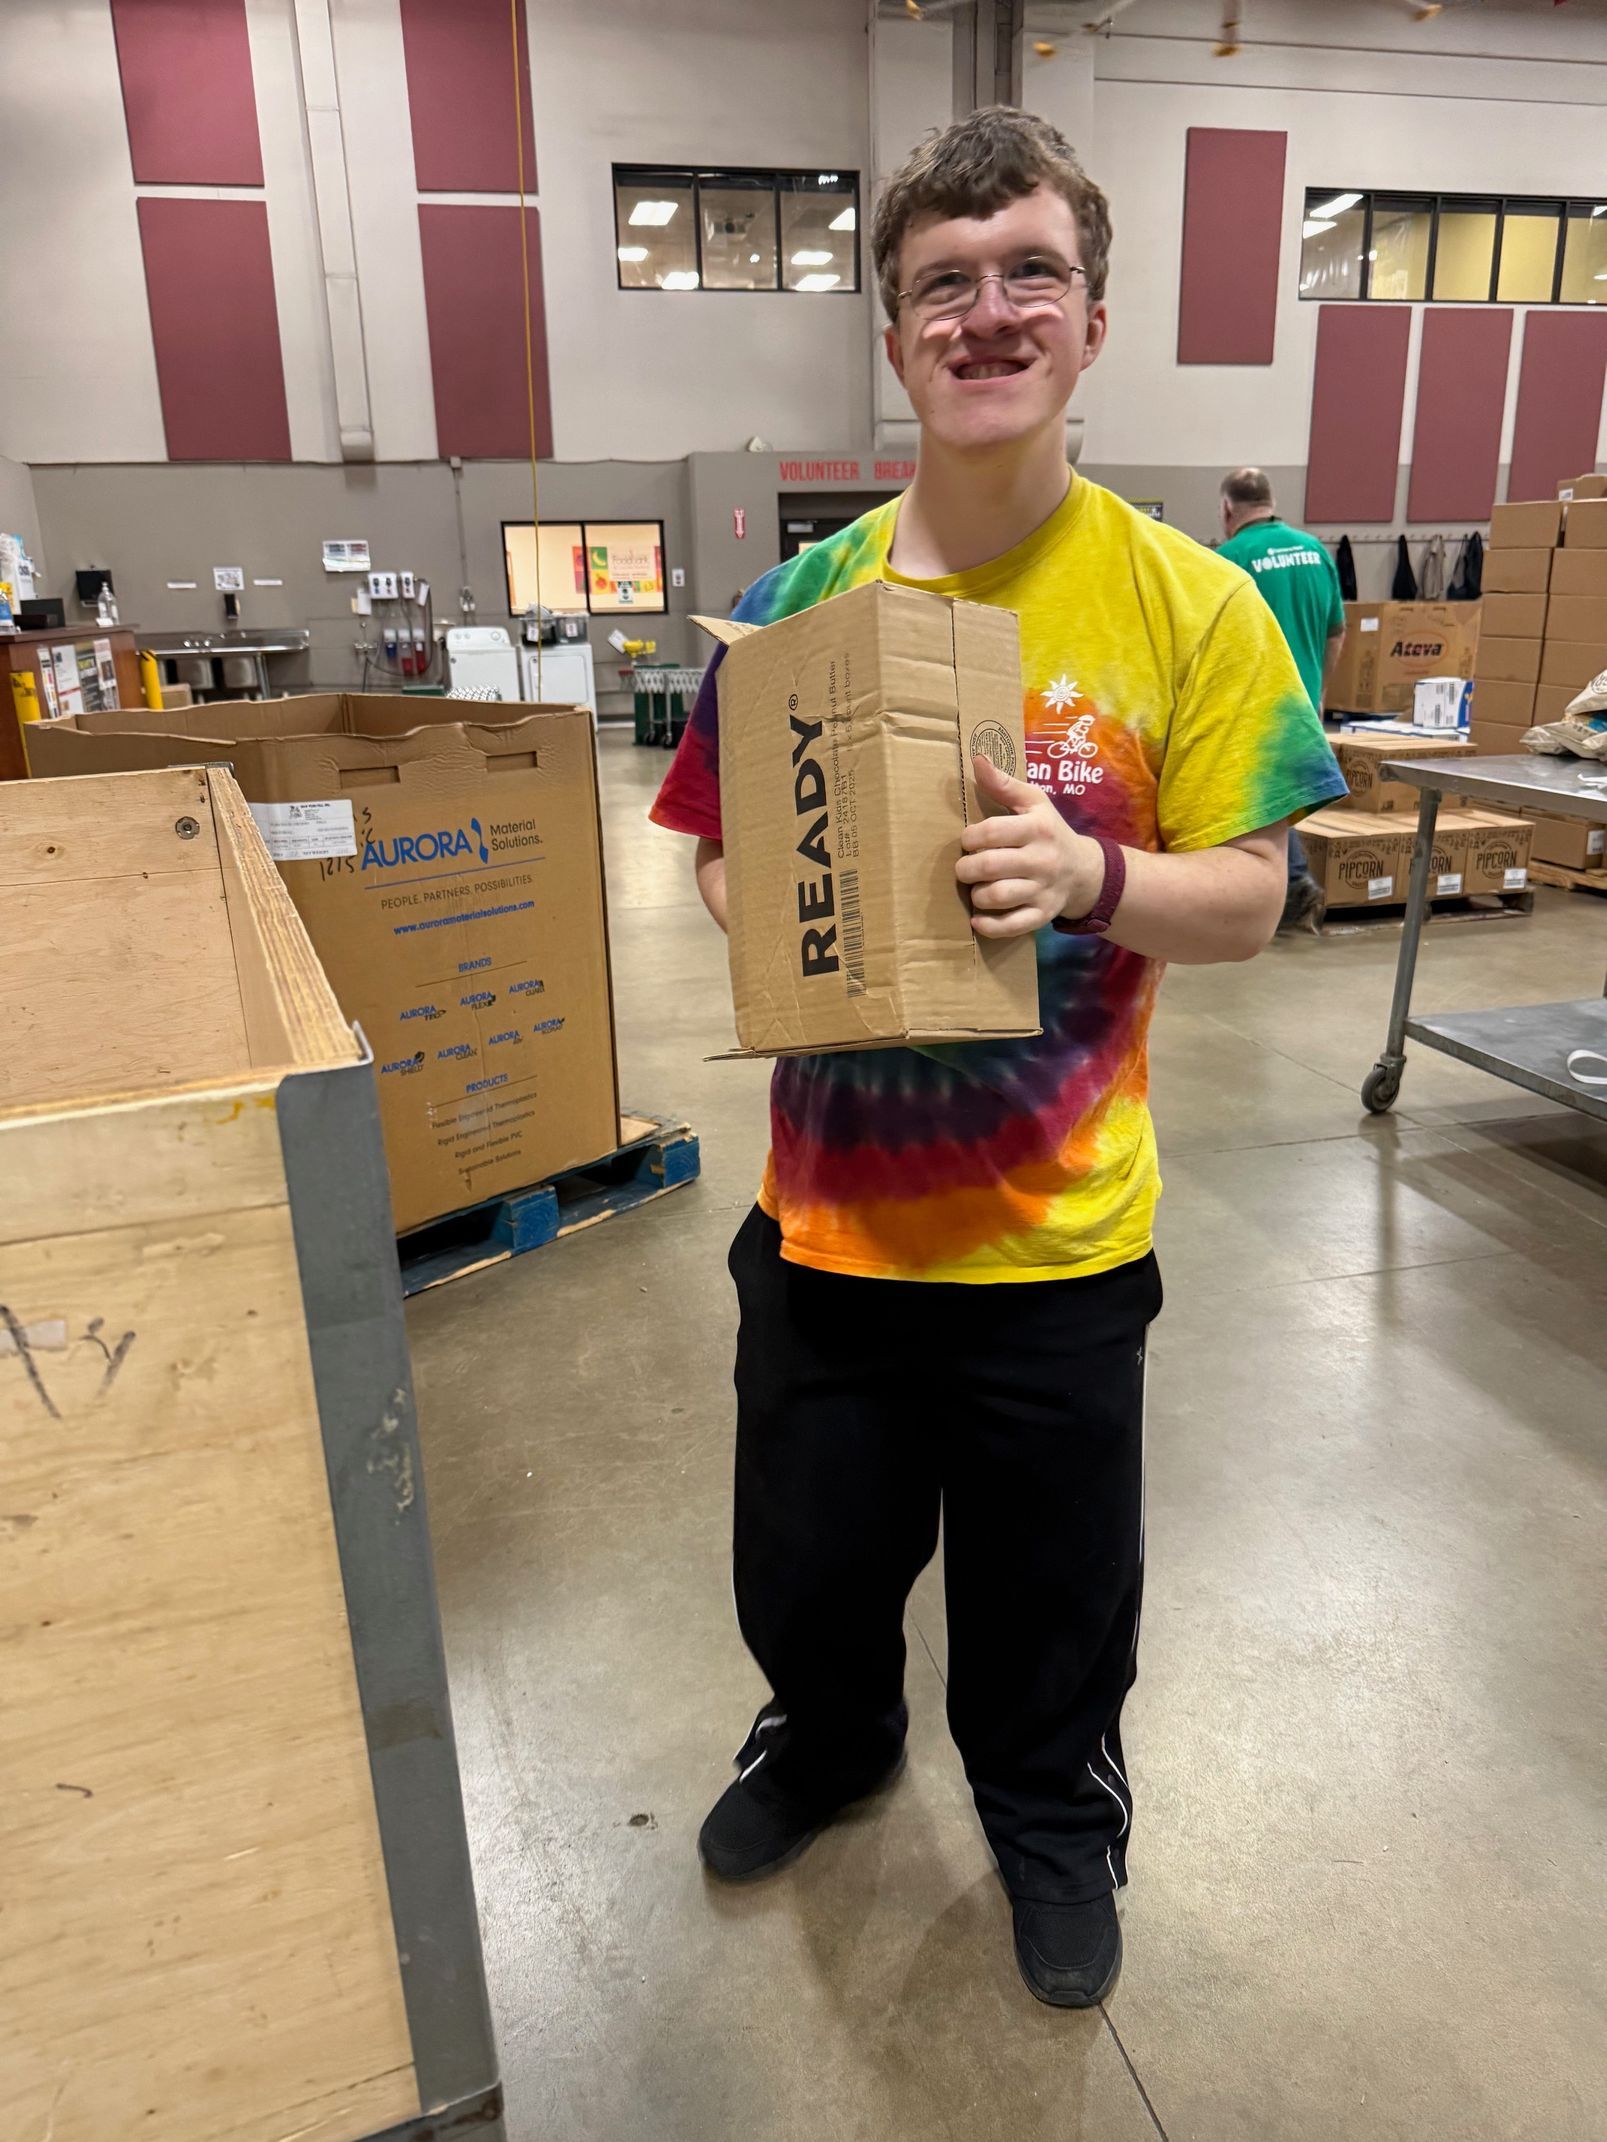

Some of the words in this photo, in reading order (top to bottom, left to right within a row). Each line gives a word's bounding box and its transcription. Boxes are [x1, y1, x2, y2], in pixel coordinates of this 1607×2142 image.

[780, 461, 859, 481] VOLUNTEER
[1251, 551, 1322, 573] VOLUNTEER
[1390, 642, 1443, 657] Ateva
[829, 661, 837, 694] Butter
[1058, 760, 1104, 784] Bike
[1063, 783, 1086, 796] MO
[361, 829, 474, 871] AURORA
[490, 819, 536, 836] Material
[491, 834, 544, 851] Solutions.
[837, 826, 845, 859] Clean
[1476, 850, 1518, 870] PIPCORN
[1338, 859, 1384, 880] PIPCORN
[381, 895, 421, 910] PEOPLE.
[393, 900, 535, 936] www.auroramaterialsolutions.com
[458, 956, 492, 972] BRANDS
[509, 979, 540, 994] AURORA
[460, 991, 492, 1007] AURORA
[400, 1005, 437, 1021] AURORA
[533, 1018, 561, 1033] AURORA
[488, 1030, 520, 1046] AURORA
[437, 1043, 471, 1060] AURORA
[381, 1057, 419, 1074] AURORA
[466, 1073, 508, 1093] PRODUCTS
